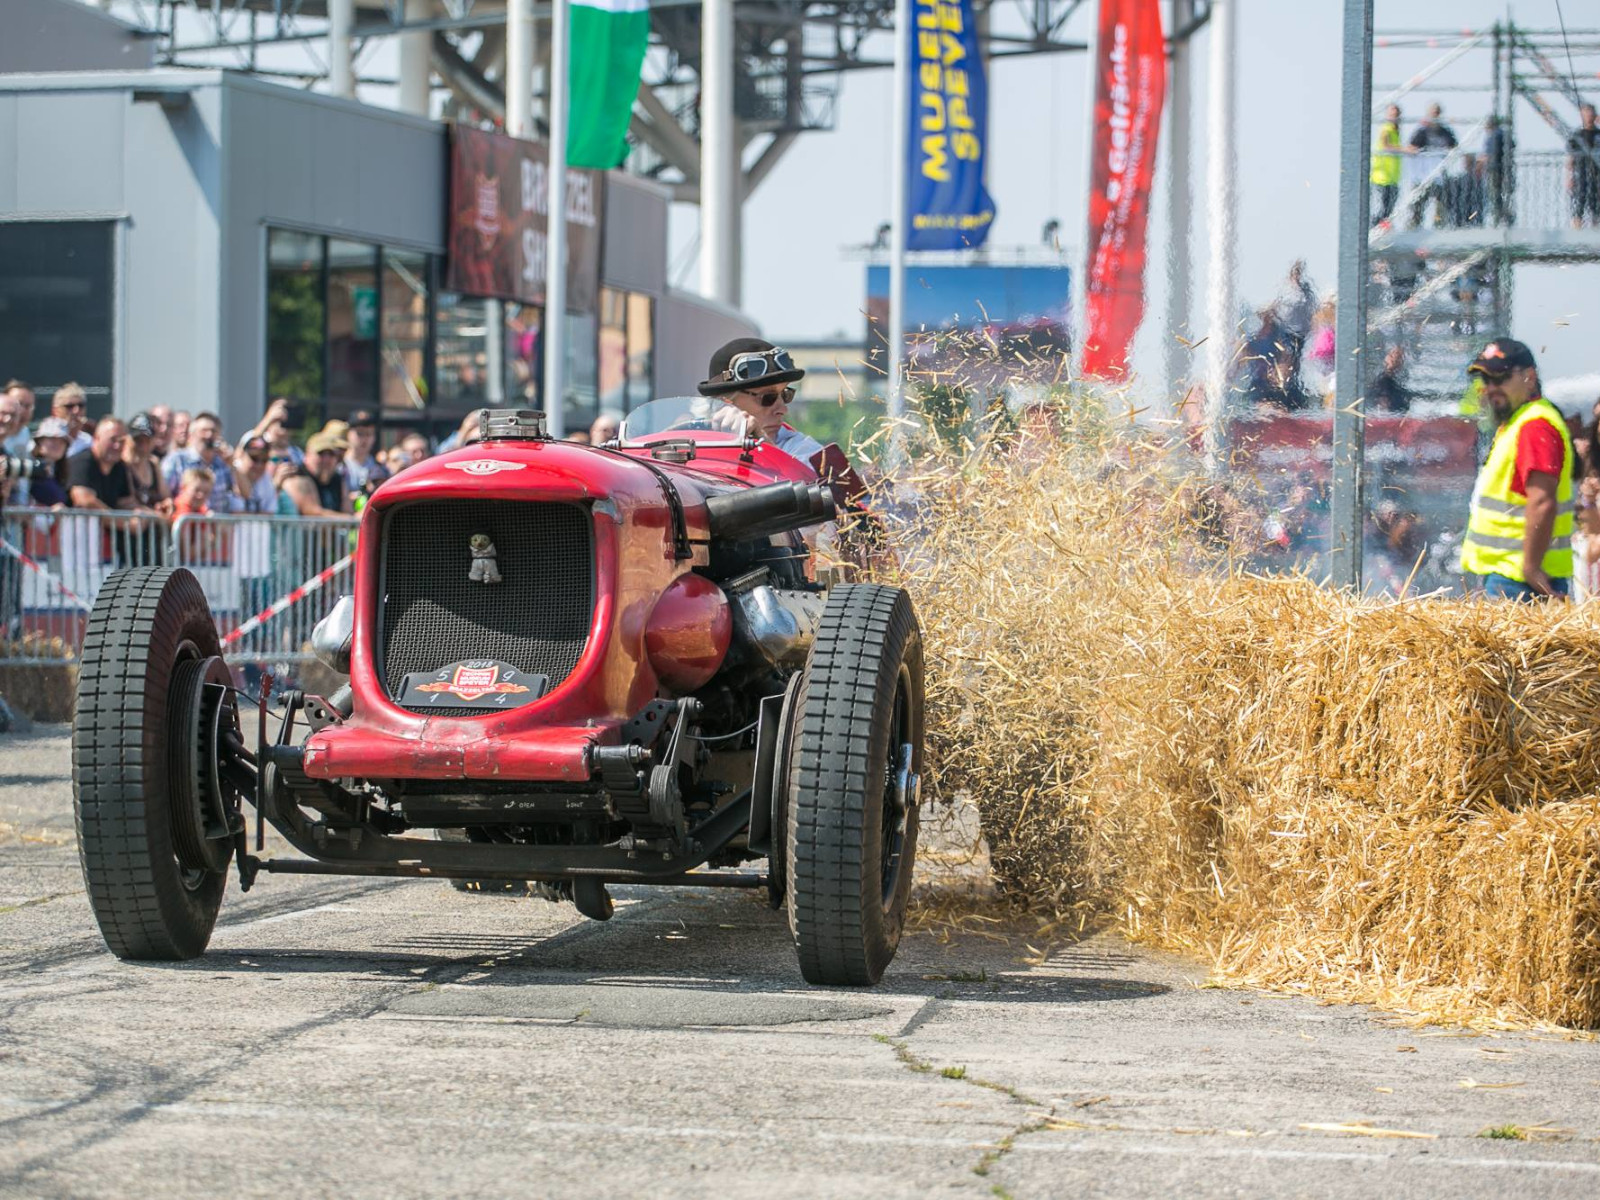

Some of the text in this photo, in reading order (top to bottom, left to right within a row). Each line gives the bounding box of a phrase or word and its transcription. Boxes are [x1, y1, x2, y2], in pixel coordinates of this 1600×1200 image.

[938, 0, 980, 162] SPEYE
[435, 670, 450, 681] 5
[502, 670, 516, 682] 9
[494, 692, 507, 704] 4
